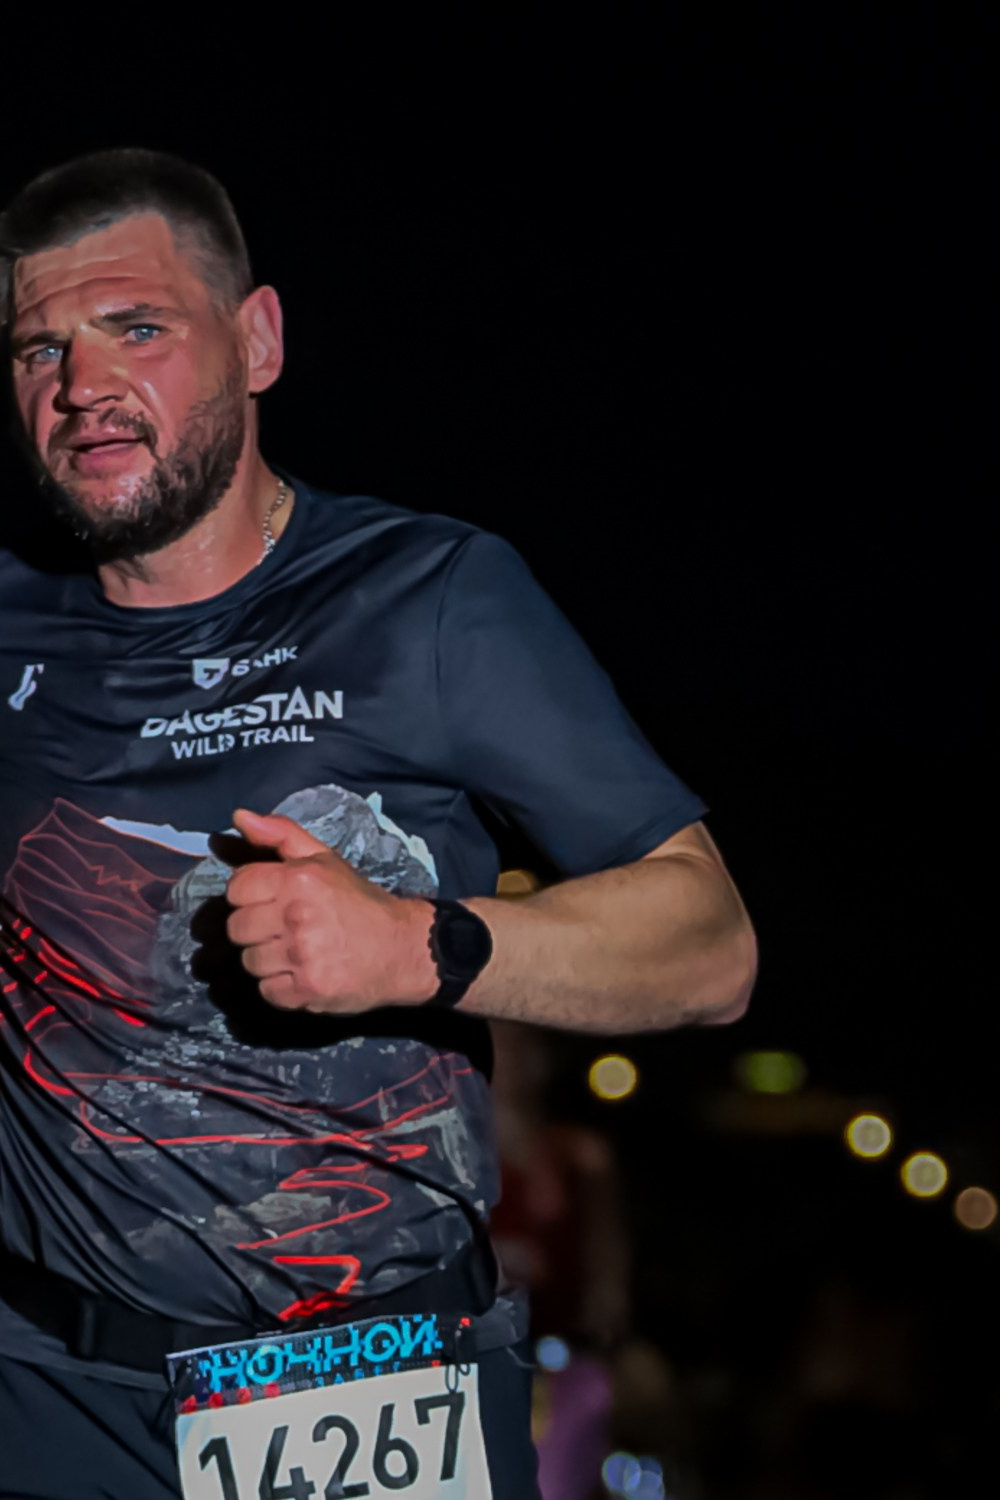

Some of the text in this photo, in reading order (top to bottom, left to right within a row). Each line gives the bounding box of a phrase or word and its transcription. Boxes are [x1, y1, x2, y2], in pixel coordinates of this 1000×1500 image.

[140, 685, 344, 738] DAGESTAN
[171, 724, 315, 760] WILD TRAIL
